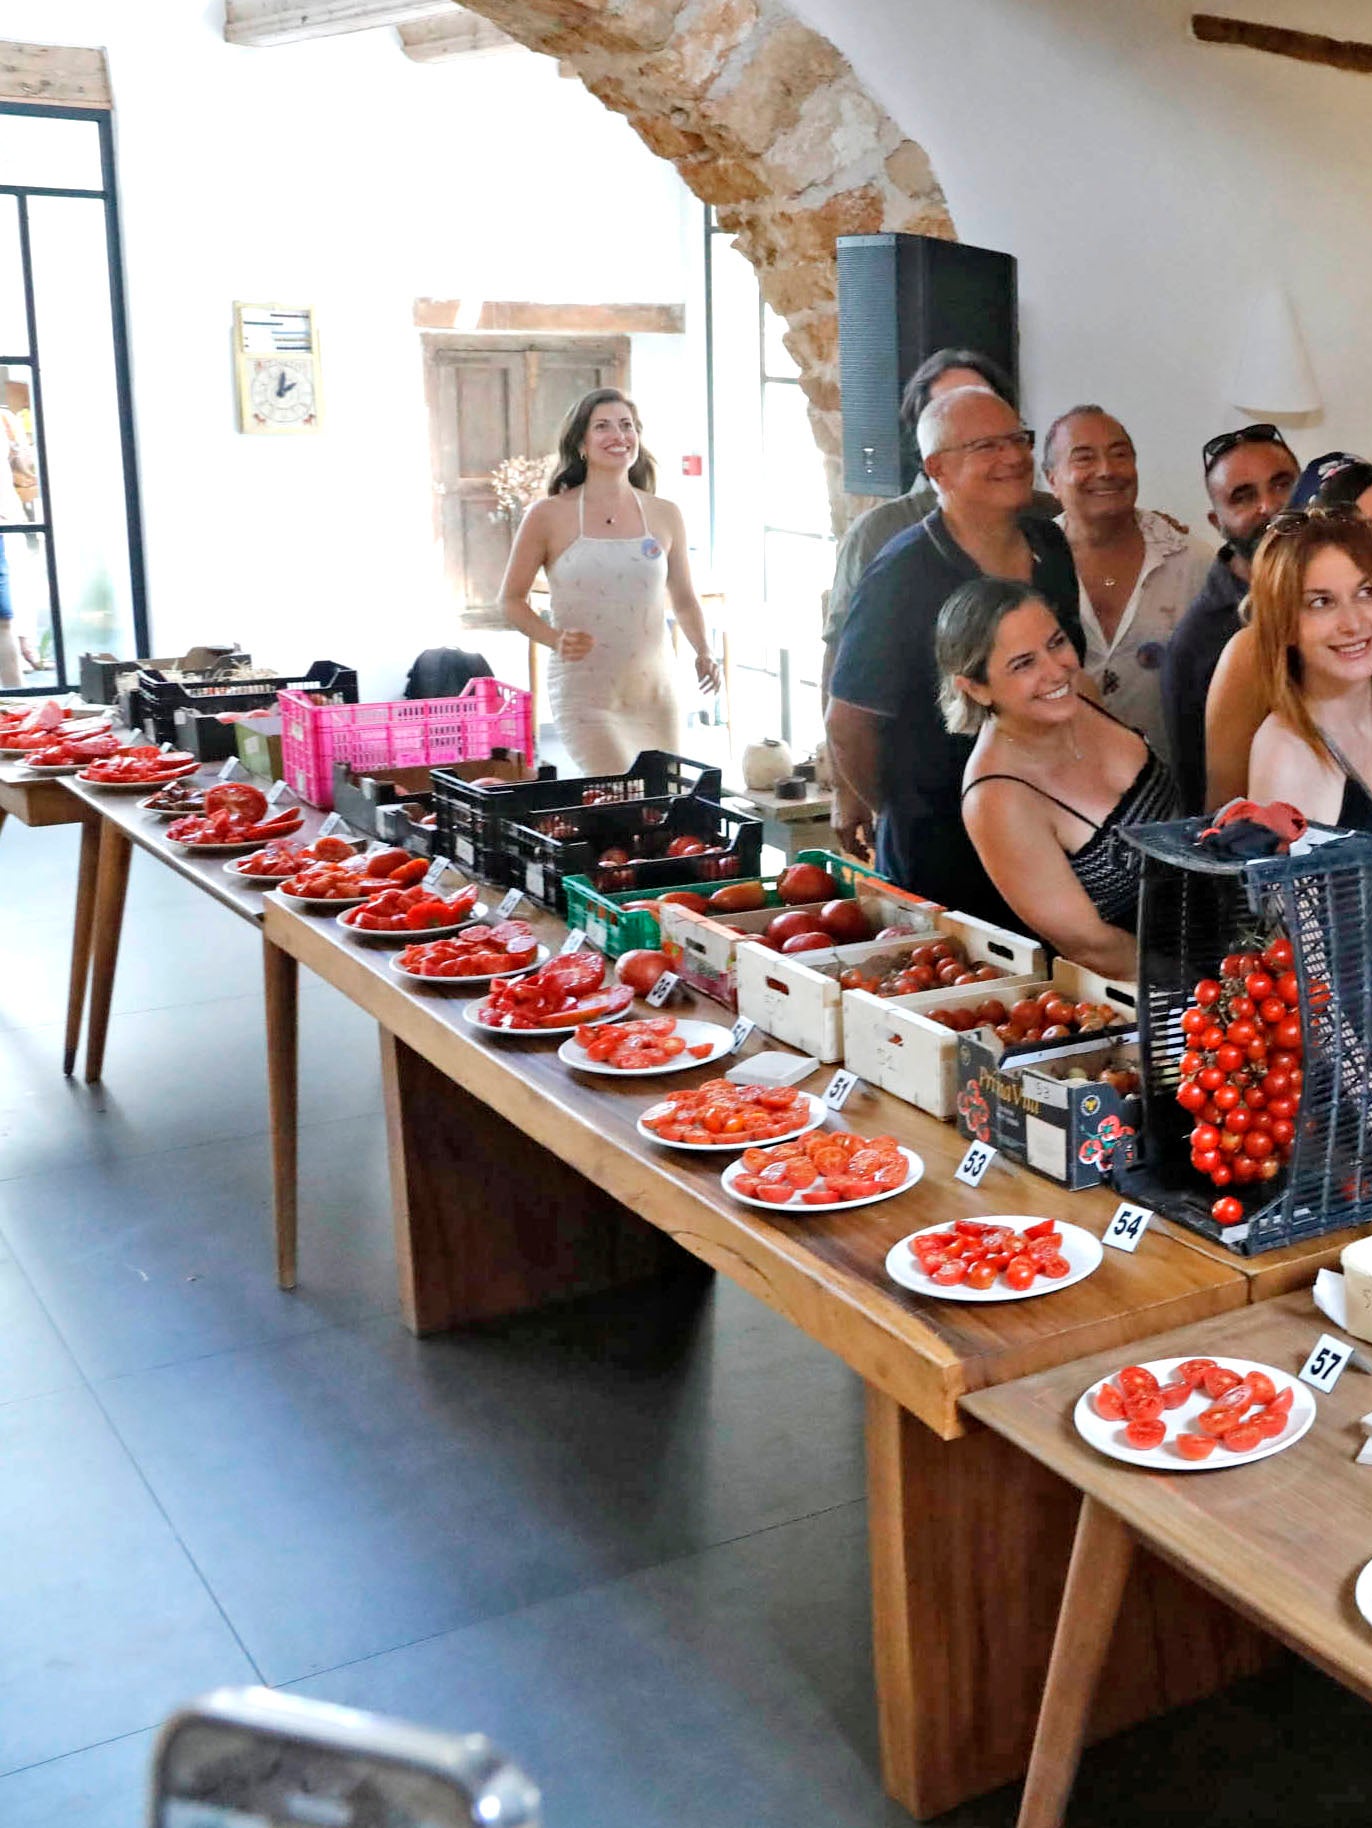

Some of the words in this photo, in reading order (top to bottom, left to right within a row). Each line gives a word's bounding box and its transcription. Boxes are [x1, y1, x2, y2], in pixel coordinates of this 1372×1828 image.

[829, 1077, 848, 1101] 51
[963, 1150, 988, 1177] 53
[1113, 1210, 1144, 1240] 54
[1310, 1347, 1343, 1381] 57
